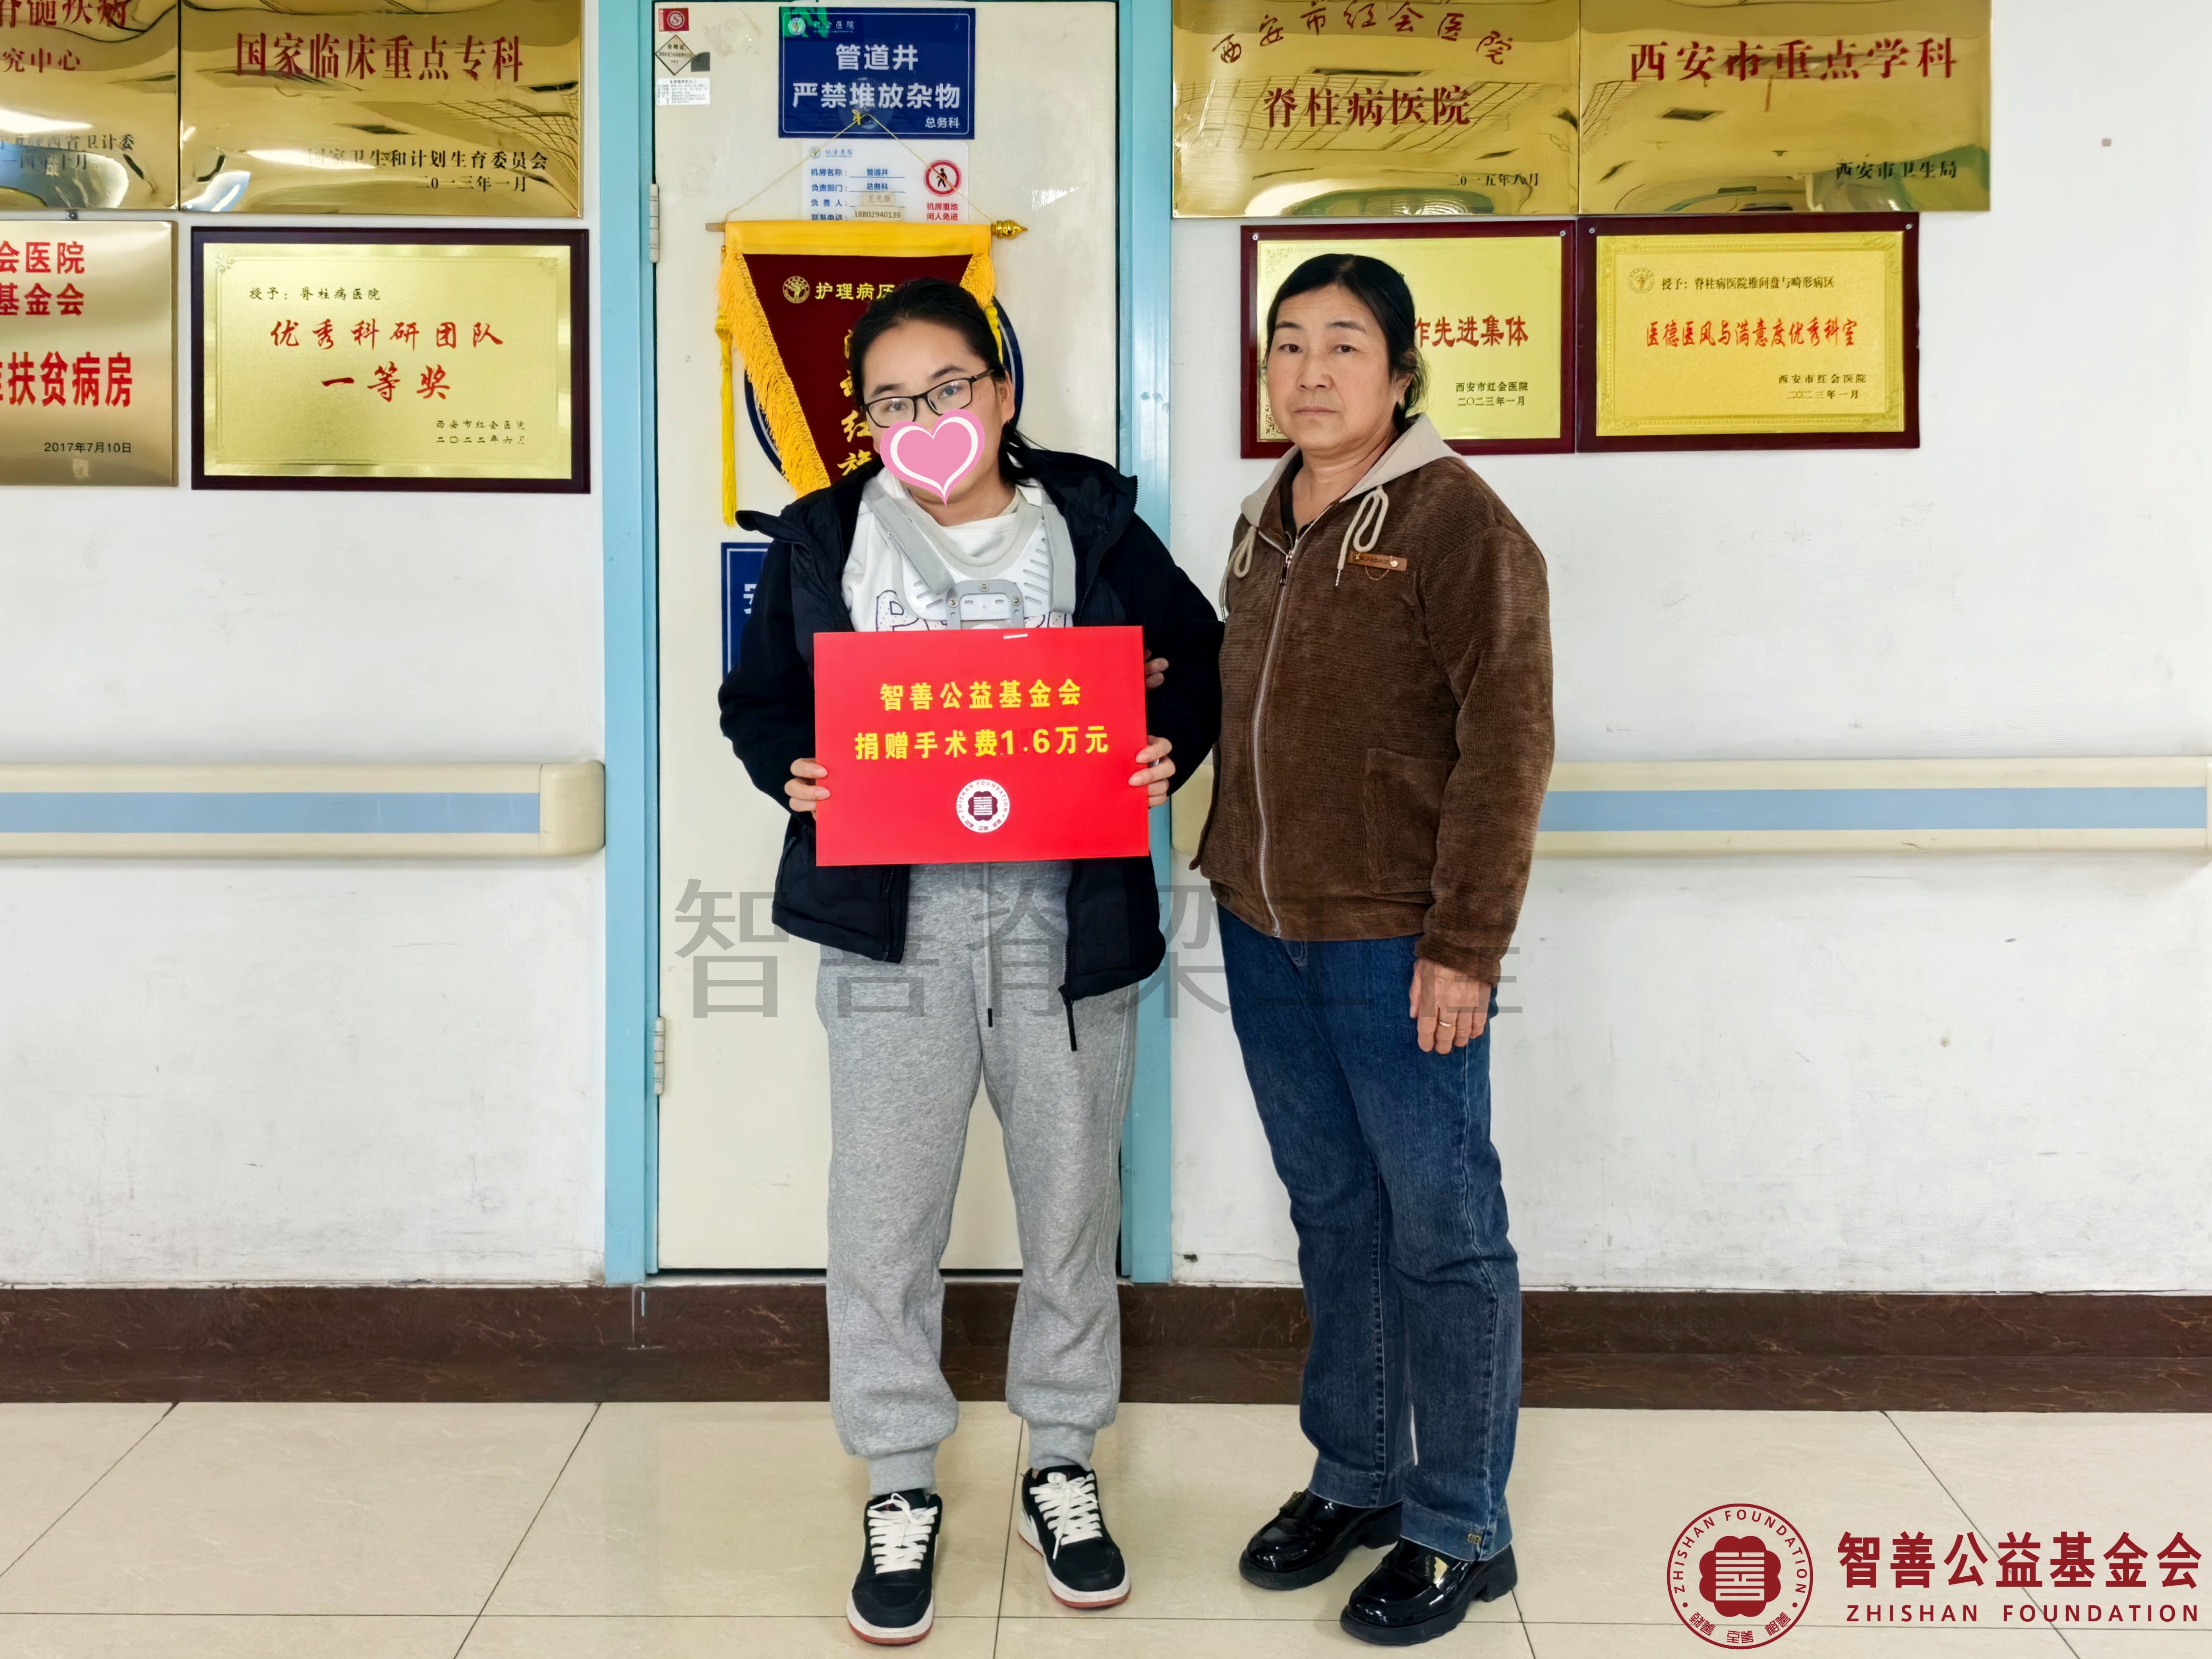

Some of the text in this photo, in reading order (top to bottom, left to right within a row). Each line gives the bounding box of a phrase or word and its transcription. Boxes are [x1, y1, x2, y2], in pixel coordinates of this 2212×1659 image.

[1212, 0, 1512, 65] 西安市红会医院
[2, 47, 80, 73] 究中心
[237, 32, 523, 82] 国家临床重点专科
[836, 44, 918, 70] 管道井
[1628, 37, 1958, 81] 西安市重点学科
[793, 82, 960, 109] 严禁堆放杂物
[1263, 85, 1471, 128] 脊柱病医院
[924, 116, 960, 129] 总务科
[1836, 161, 1957, 180] 西安市卫生局
[0, 241, 85, 274] 会医院
[0, 283, 85, 316] 基金会
[270, 318, 504, 352] 优秀科研团队
[1646, 316, 1858, 348] 医德医风与满意度优秀科室
[0, 351, 133, 407] 扶贫病房
[321, 361, 451, 403] 一等奖
[1456, 381, 1529, 392] 西安市红会医院
[1778, 374, 1866, 384] 西安市红会医院
[436, 419, 526, 430] 西安市红会医院
[44, 442, 132, 454] 2017年7月10日
[880, 678, 1081, 711] 智善公益基金会
[855, 725, 1109, 761] 捐赠手术费1.6万元
